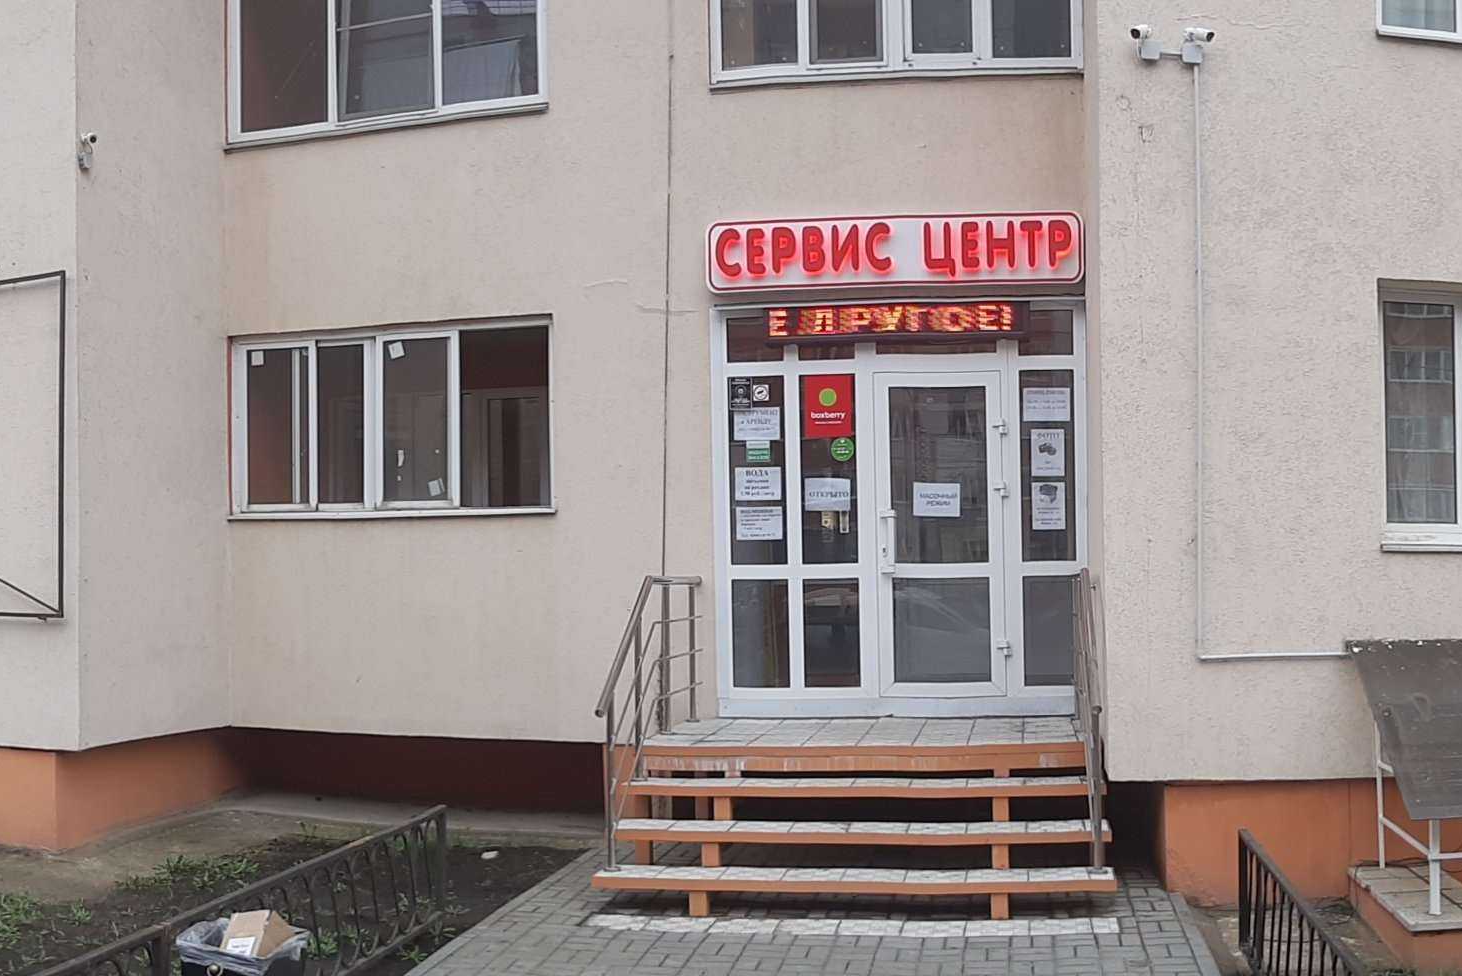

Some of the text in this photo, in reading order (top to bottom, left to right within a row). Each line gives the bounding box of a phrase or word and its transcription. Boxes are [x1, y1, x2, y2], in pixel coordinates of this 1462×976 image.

[714, 219, 1073, 278] СЕРВИС ЦЕНТР
[810, 410, 846, 420] boxberry
